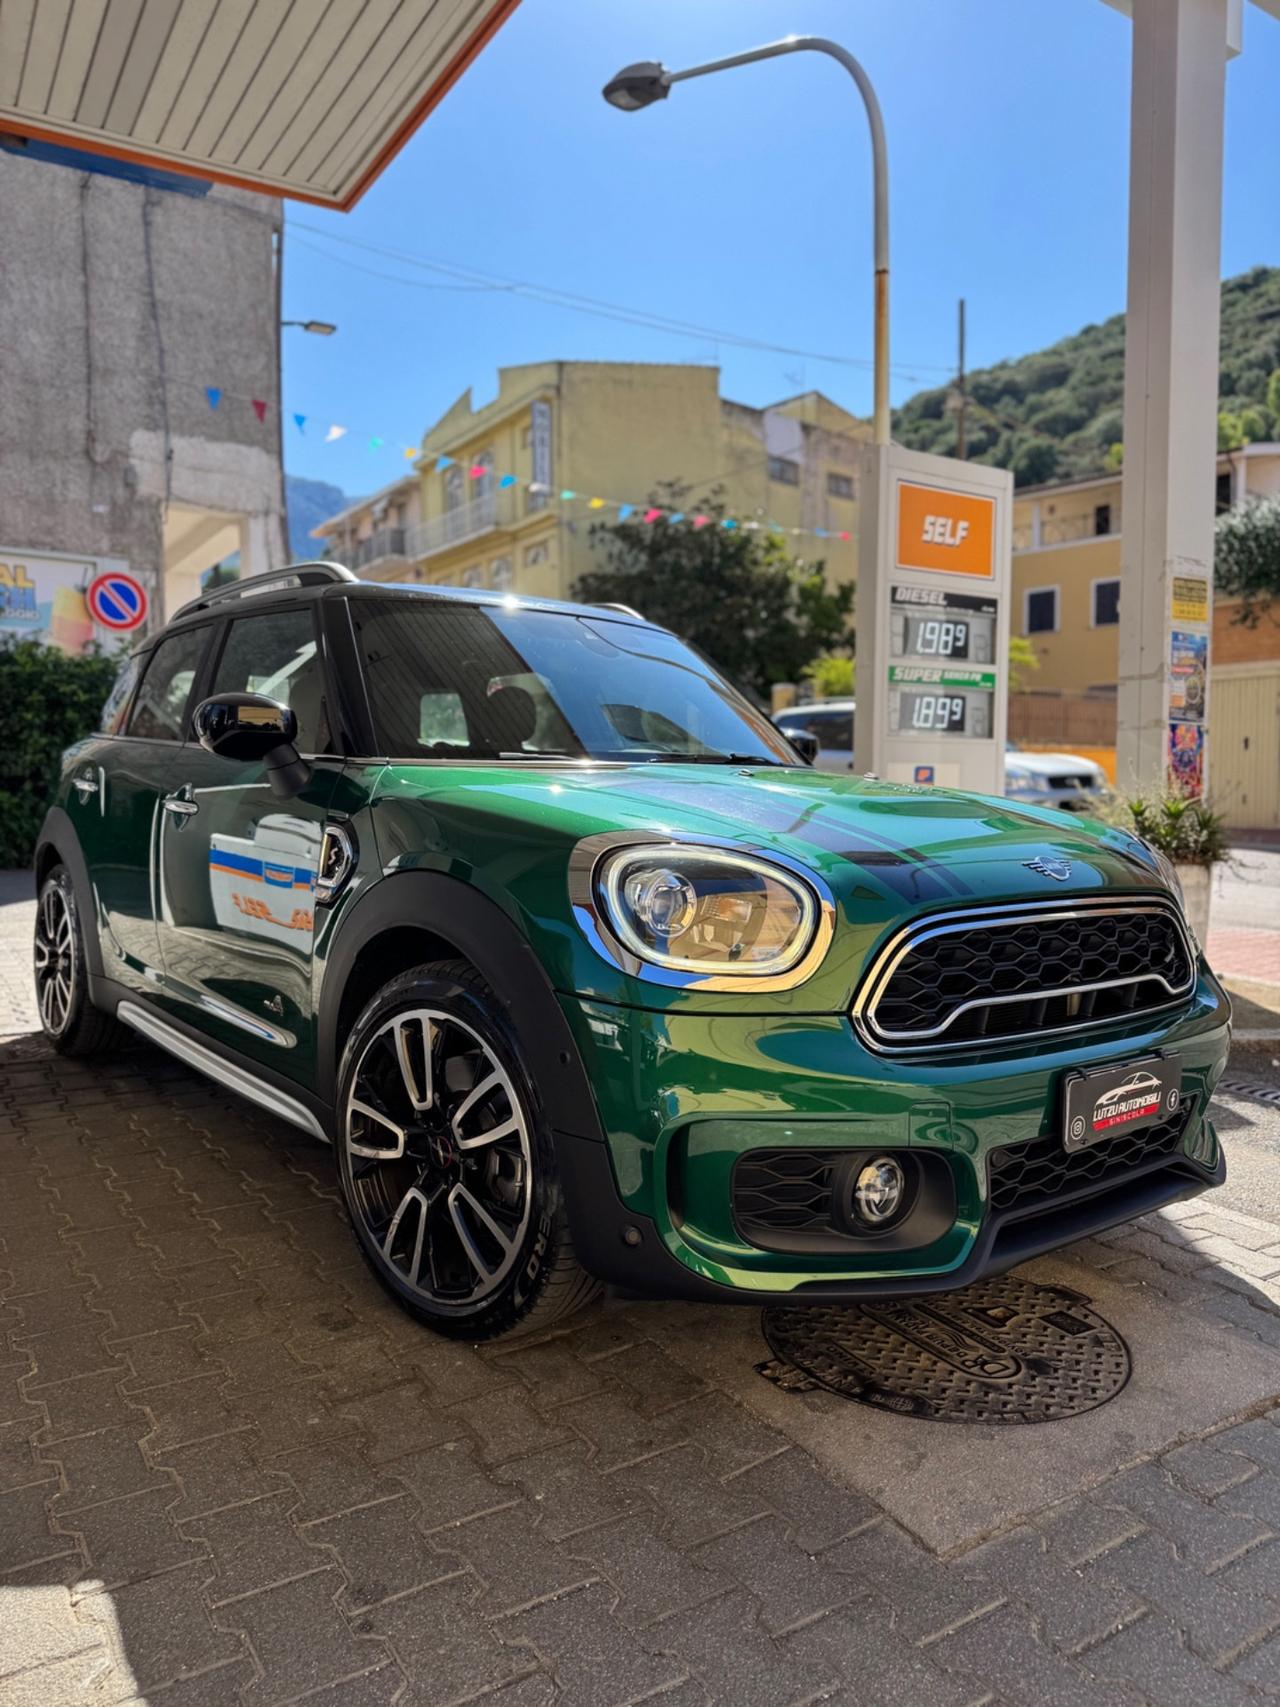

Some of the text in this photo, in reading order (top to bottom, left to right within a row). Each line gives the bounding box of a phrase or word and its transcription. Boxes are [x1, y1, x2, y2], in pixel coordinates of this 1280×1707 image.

[921, 515, 970, 546] SELF
[895, 587, 948, 605] DIESEL
[893, 666, 942, 682] SUPER
[1093, 1092, 1162, 1122] LUTZU AUTOMOBILI
